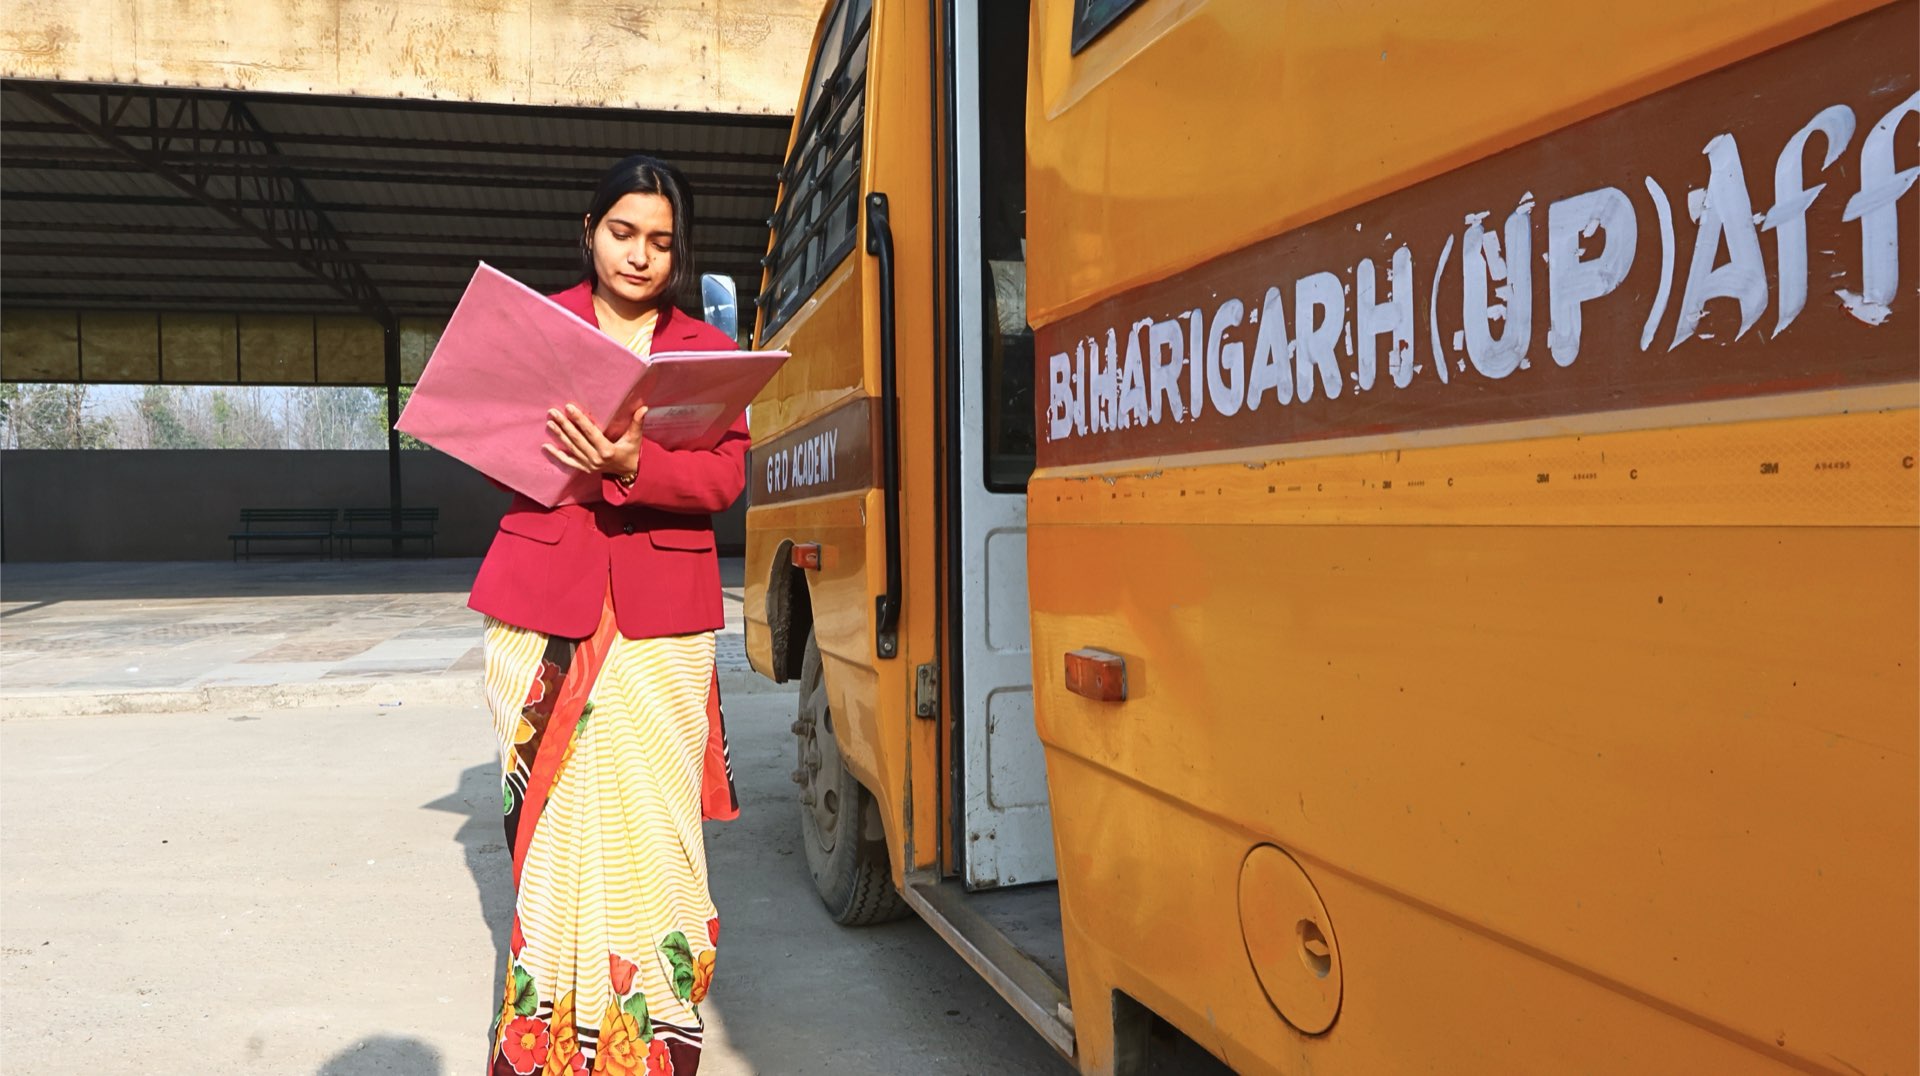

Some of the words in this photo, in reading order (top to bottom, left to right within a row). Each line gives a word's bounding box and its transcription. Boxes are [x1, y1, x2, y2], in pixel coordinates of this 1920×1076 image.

[792, 427, 838, 487] ACADEMY
[1536, 473, 1550, 484] 3M
[1629, 469, 1638, 480] C
[1760, 462, 1779, 474] 3M
[1902, 456, 1914, 469] C
